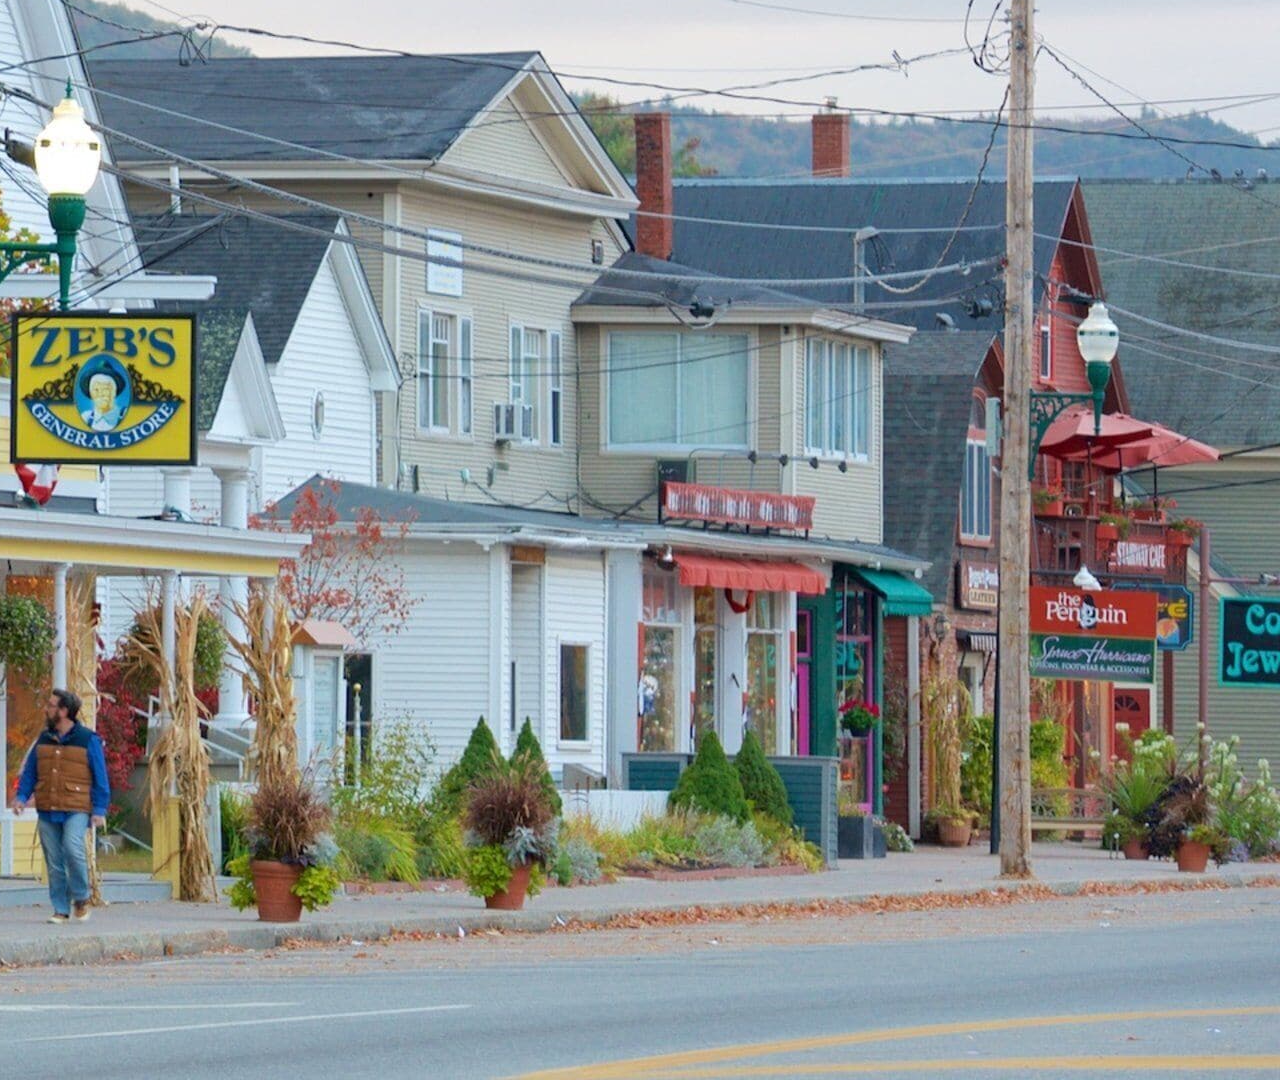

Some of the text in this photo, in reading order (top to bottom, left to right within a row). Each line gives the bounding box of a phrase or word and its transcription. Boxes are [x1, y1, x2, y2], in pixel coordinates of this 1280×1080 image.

[30, 326, 176, 368] ZEB'S
[31, 402, 174, 449] GENERAL STORE
[1046, 601, 1127, 629] Penguin
[1058, 591, 1081, 607] the
